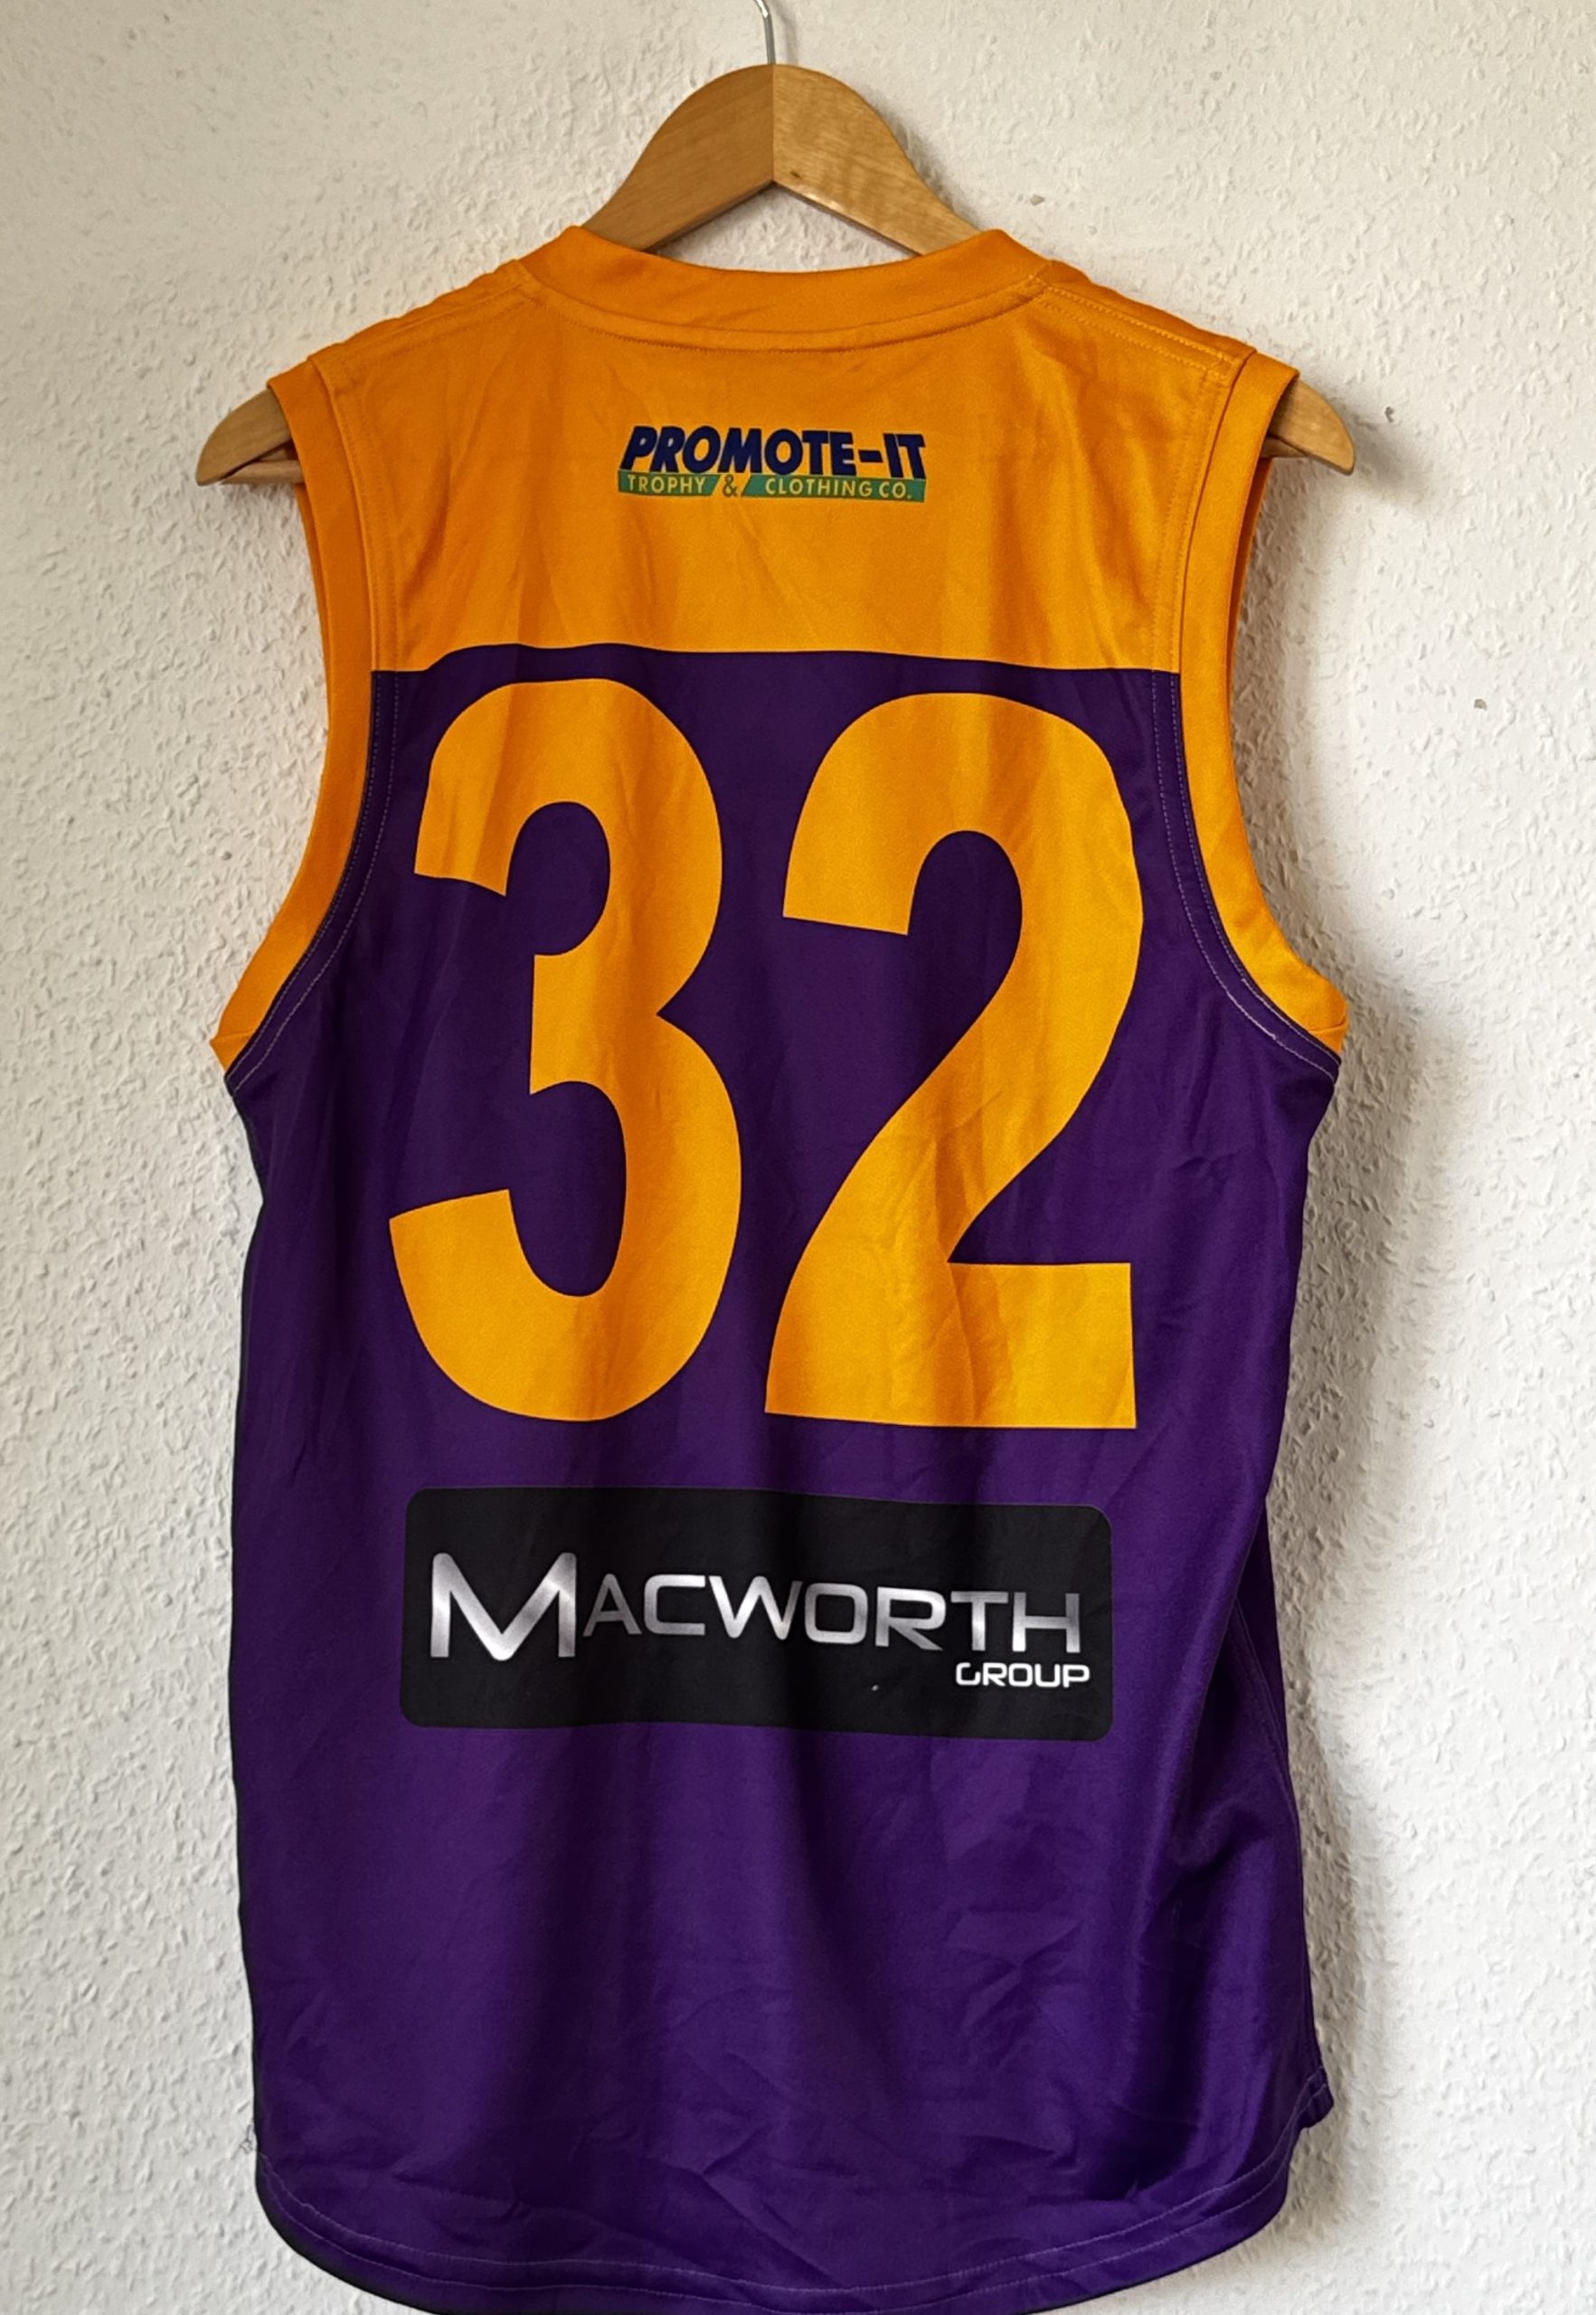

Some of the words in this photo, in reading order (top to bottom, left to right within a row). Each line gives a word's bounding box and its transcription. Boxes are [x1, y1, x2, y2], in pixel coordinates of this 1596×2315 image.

[619, 425, 926, 478] PROMOTE-IT
[628, 475, 707, 495] TROPHY
[722, 475, 738, 497] &
[765, 477, 873, 497] CLOTHING
[878, 480, 912, 499] CO.
[389, 677, 1143, 1429] 32
[430, 1552, 1081, 1661] MACWORTH
[955, 1662, 1091, 1688] GROUP
